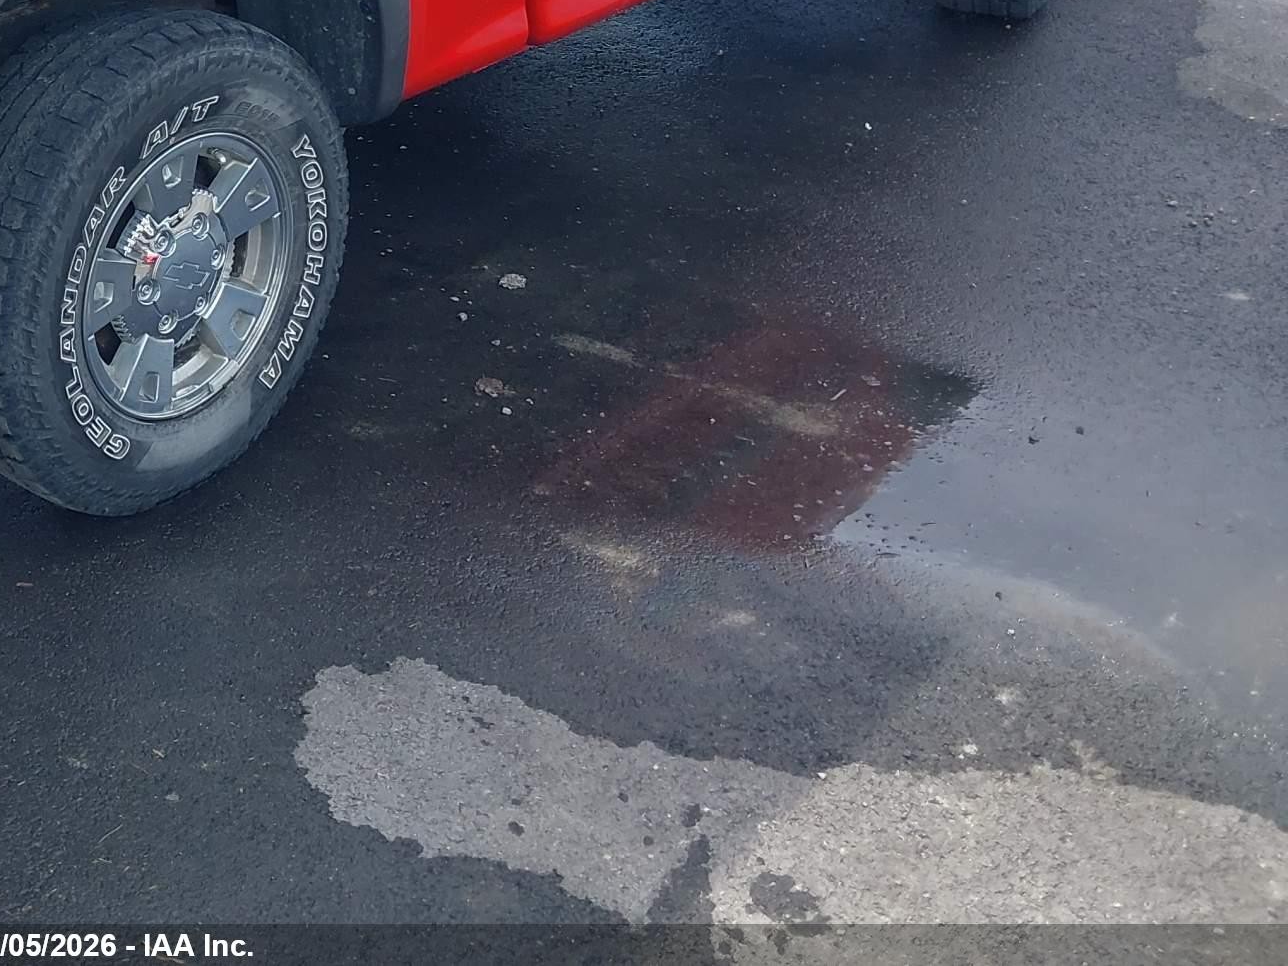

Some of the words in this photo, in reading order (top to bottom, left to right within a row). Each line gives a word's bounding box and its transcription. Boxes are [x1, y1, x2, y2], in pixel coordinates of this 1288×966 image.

[60, 166, 131, 460] GEOLANDAR
[140, 95, 220, 160] A/T
[260, 134, 328, 389] YOKOHAMA
